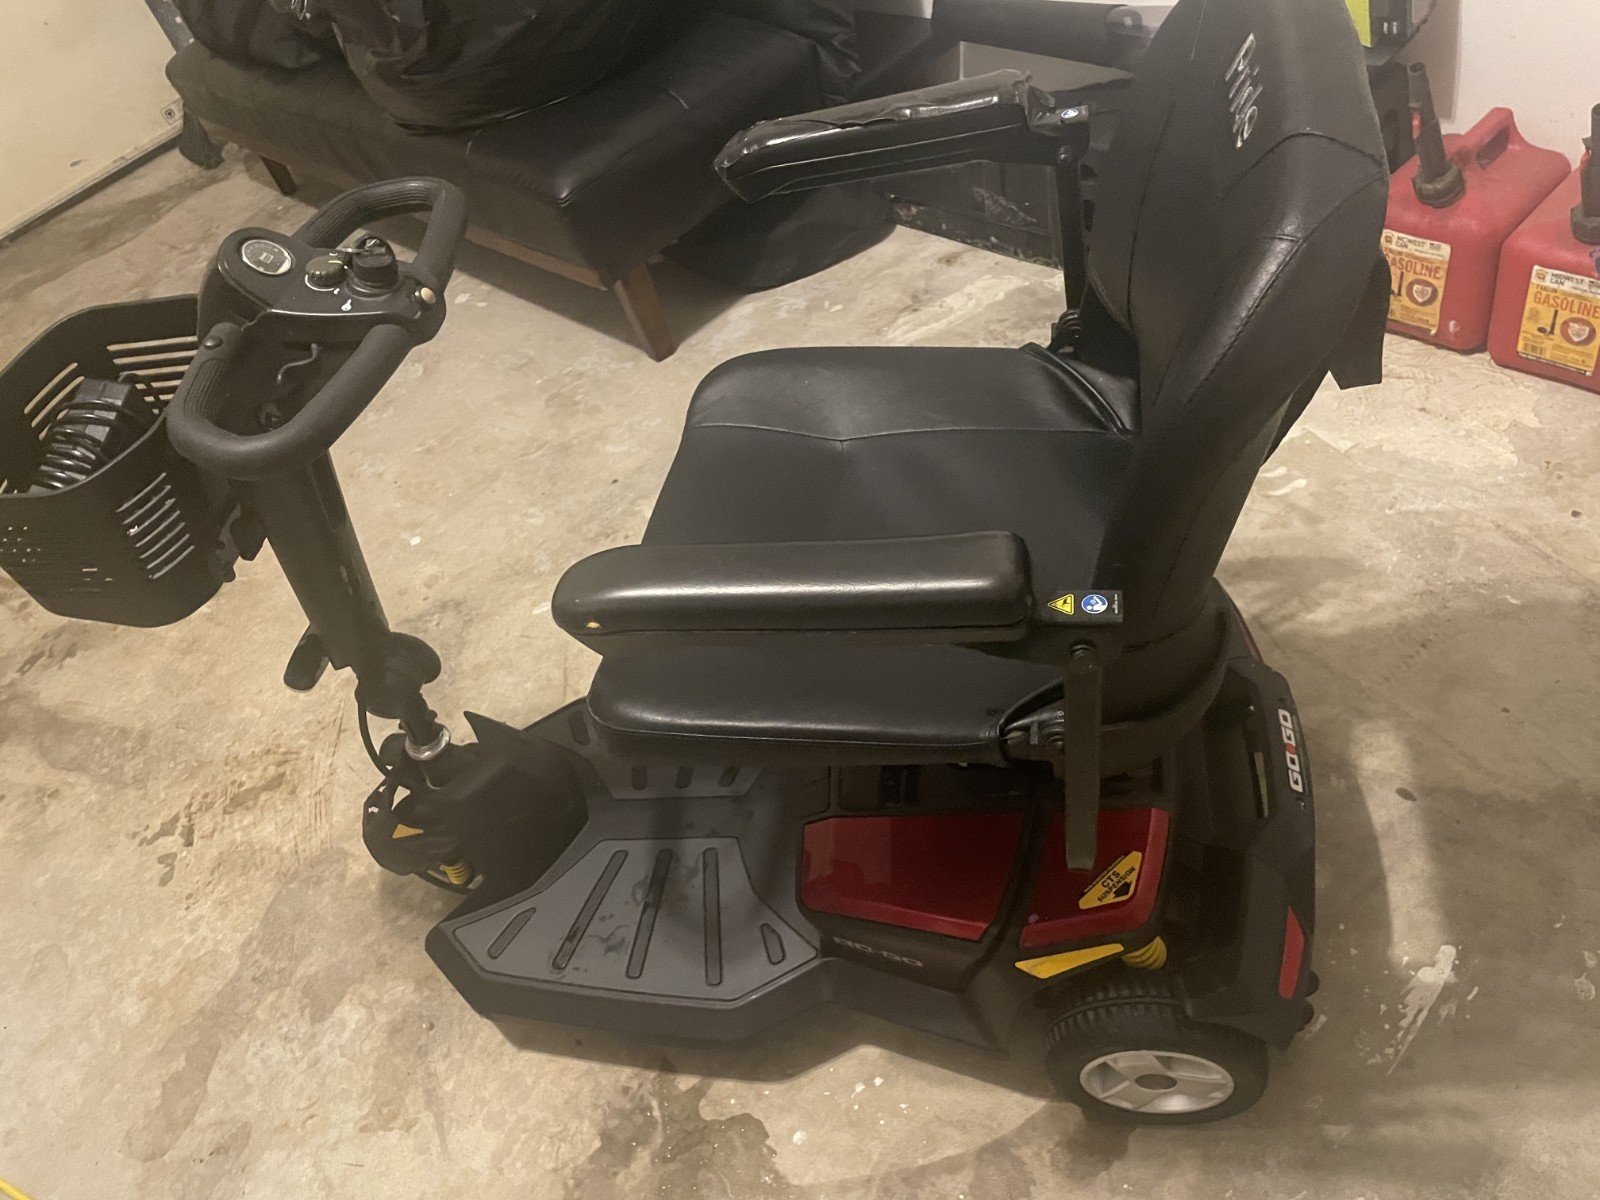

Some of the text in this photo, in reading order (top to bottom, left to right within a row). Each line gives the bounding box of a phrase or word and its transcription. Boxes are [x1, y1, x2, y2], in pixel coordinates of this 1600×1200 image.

[1551, 272, 1586, 285] MIDWEST
[1533, 290, 1600, 319] GASOLINE
[1097, 866, 1136, 903] SUSPENSION
[1101, 870, 1121, 888] CTS
